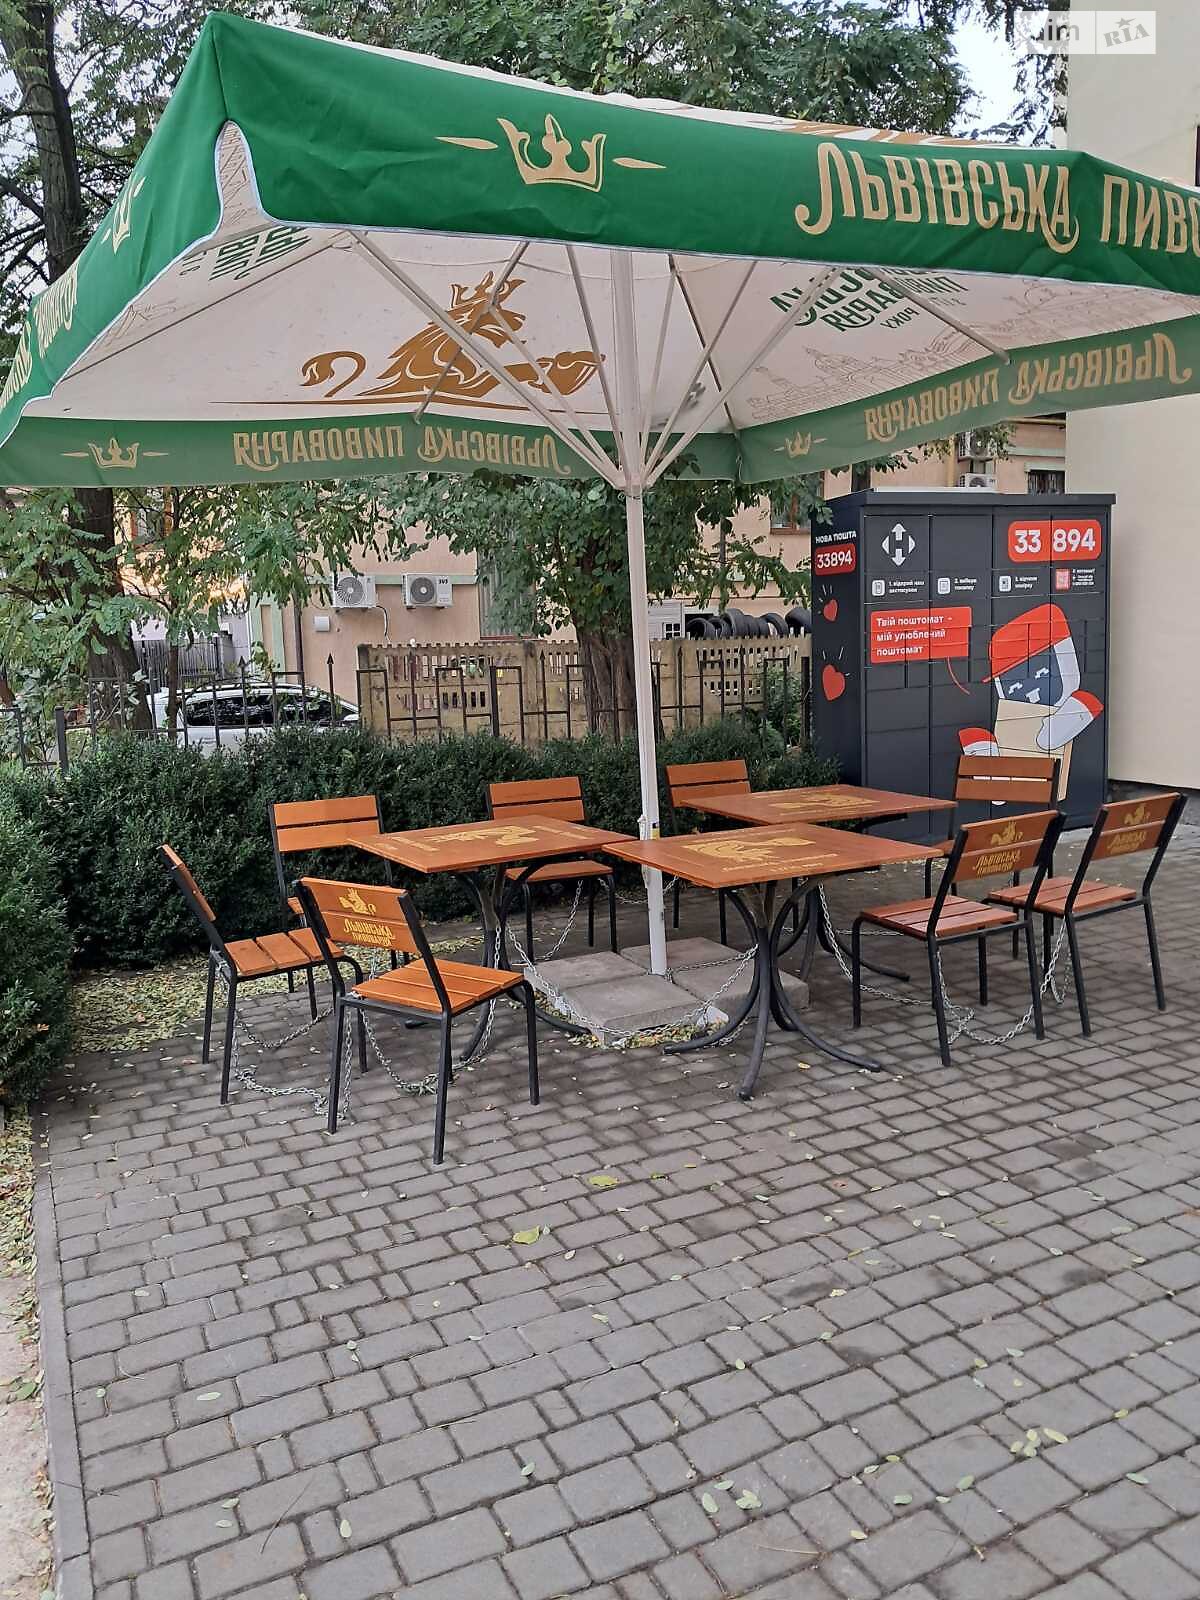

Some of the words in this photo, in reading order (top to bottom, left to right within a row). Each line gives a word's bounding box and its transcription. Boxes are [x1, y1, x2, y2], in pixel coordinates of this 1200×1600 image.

[795, 143, 1079, 254] ЛЬВІВСЬКА
[815, 534, 833, 544] НОВА
[833, 530, 857, 541] ПОШТА
[1014, 529, 1042, 554] 33
[1052, 528, 1096, 553] 894
[816, 549, 853, 569] 33894
[876, 616, 896, 627] Твій
[897, 615, 945, 625] поштомат
[876, 632, 893, 643] мій
[894, 628, 946, 643] улюблений
[876, 646, 924, 657] поштомат
